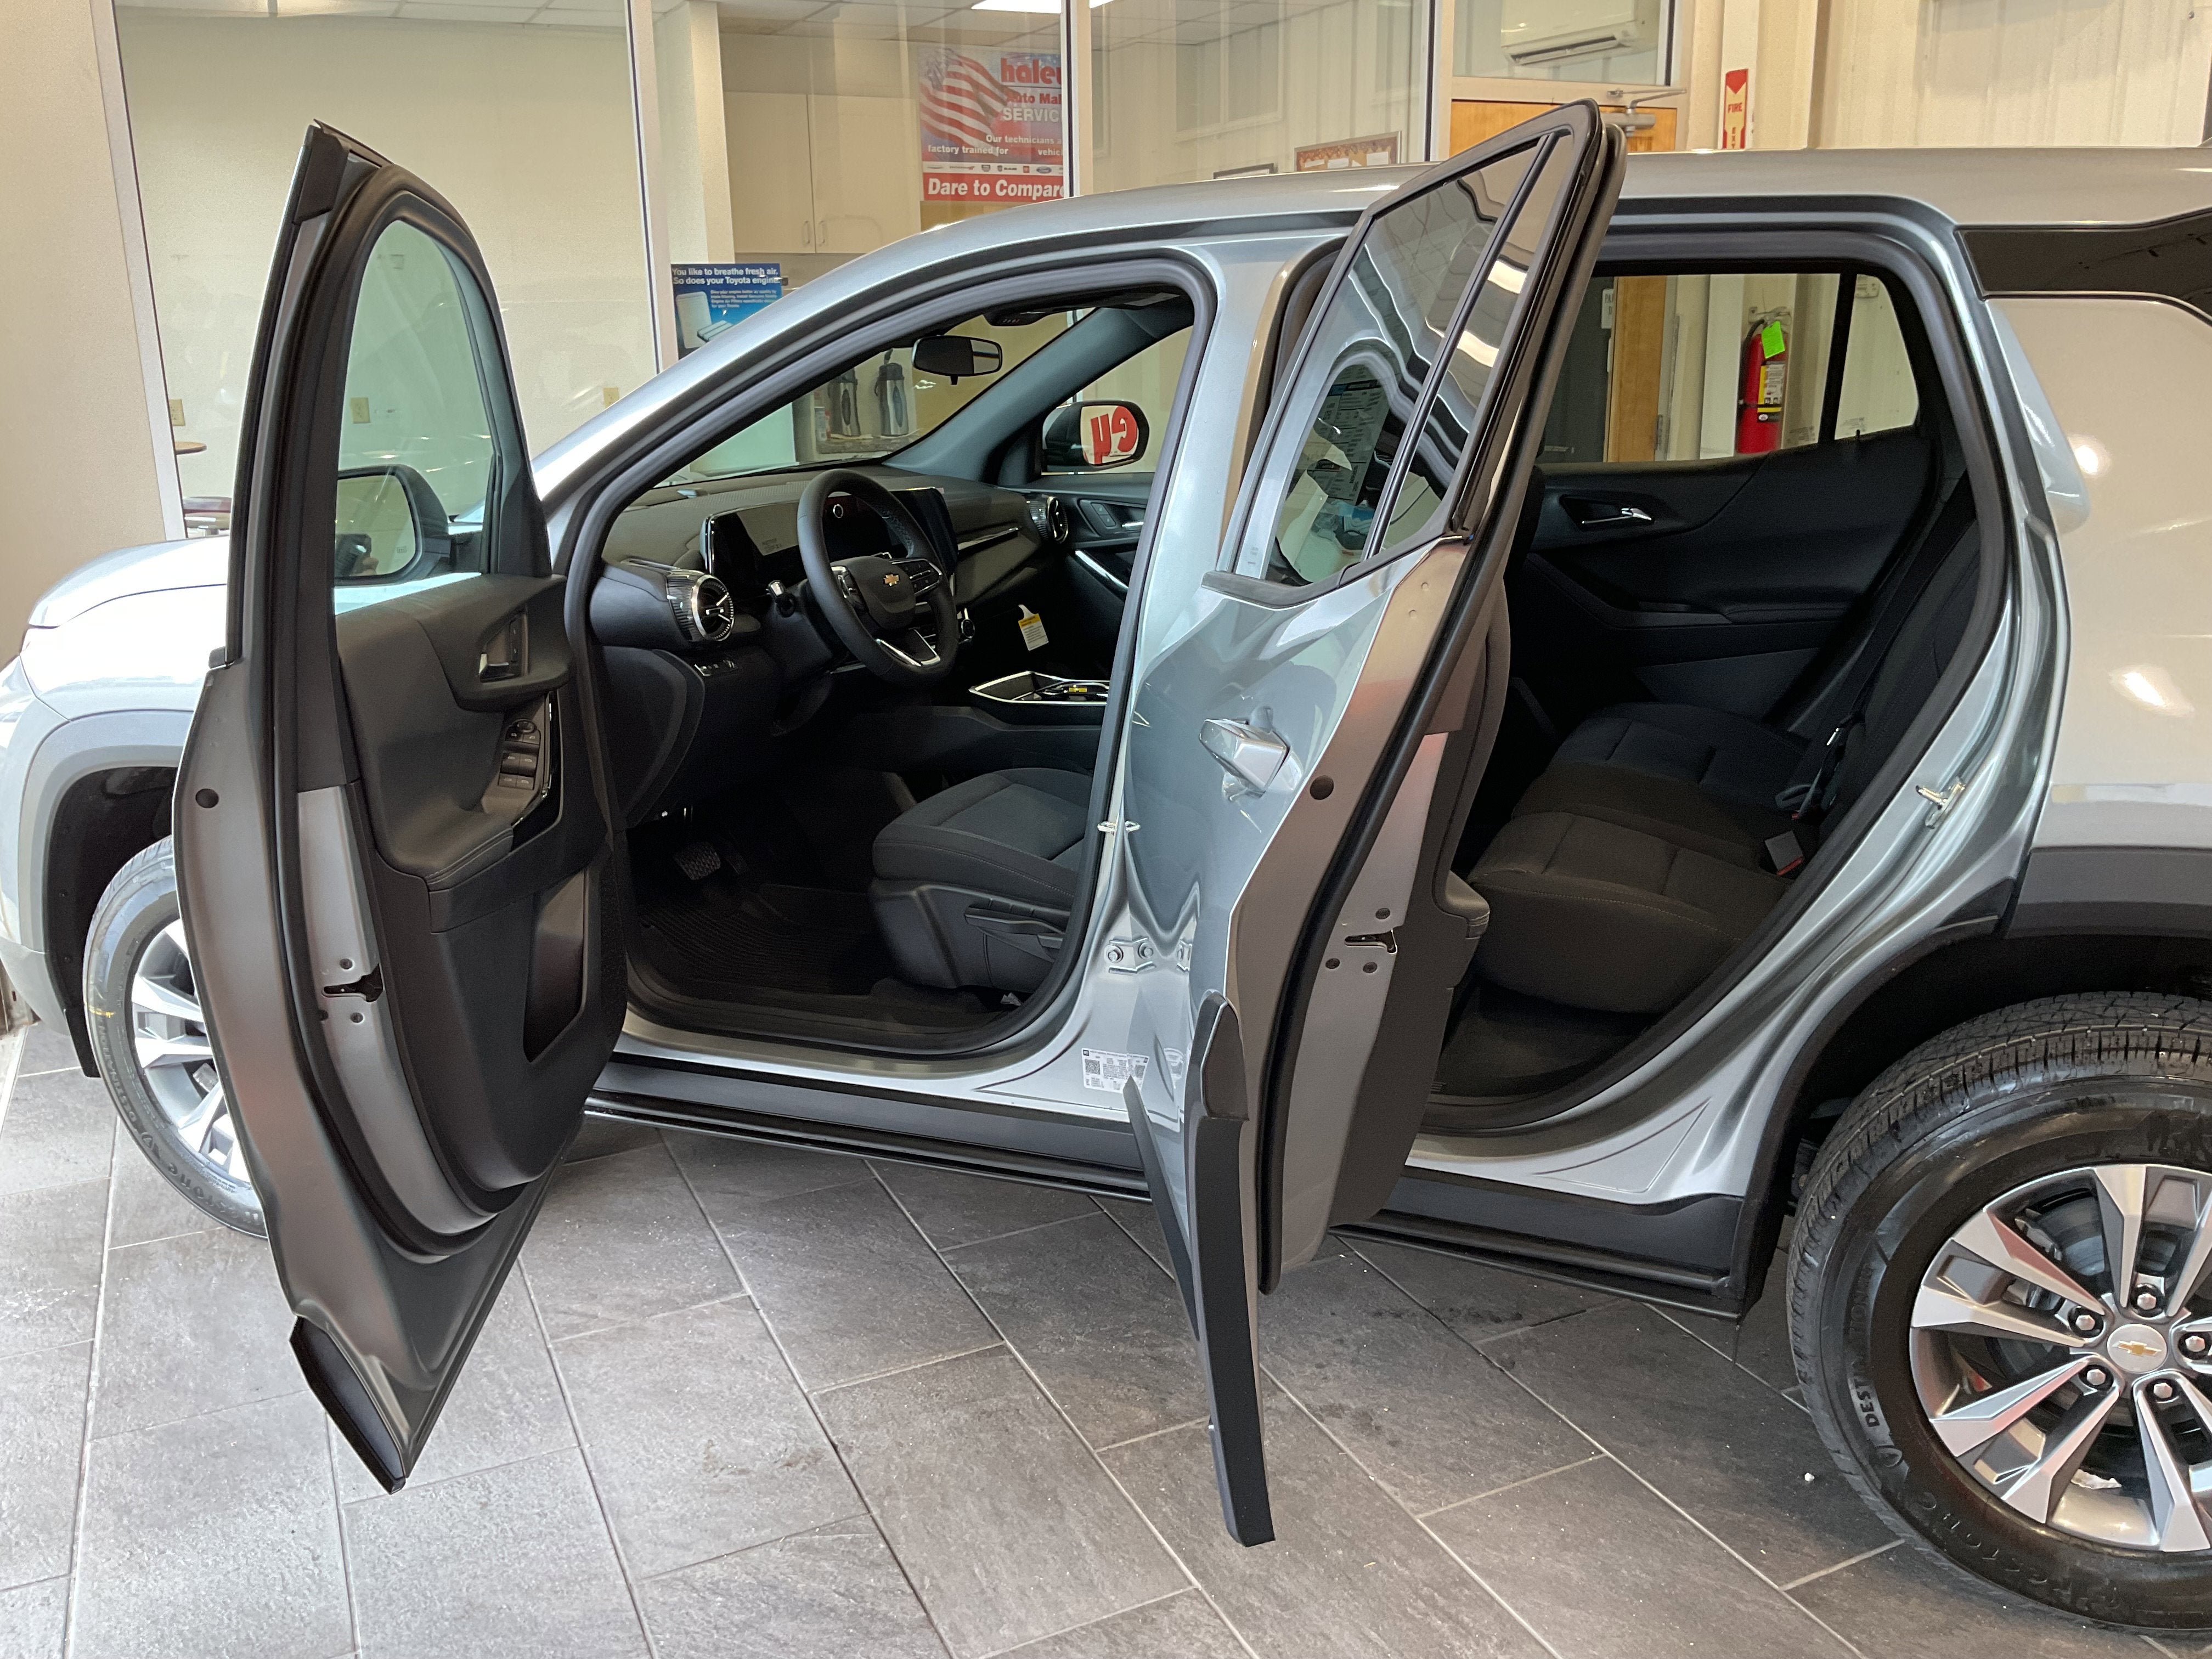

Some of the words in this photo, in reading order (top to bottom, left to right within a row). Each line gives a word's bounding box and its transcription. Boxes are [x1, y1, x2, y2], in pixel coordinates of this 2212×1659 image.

[1728, 103, 1742, 114] FIRE
[1002, 107, 1062, 123] SERVIC
[986, 134, 1002, 143] Our
[1005, 135, 1054, 144] technicians
[928, 144, 960, 155] factory
[962, 145, 993, 154] trained
[996, 146, 1009, 155] for
[928, 178, 968, 195] Dare
[973, 180, 990, 196] to
[725, 276, 751, 285] Toyota
